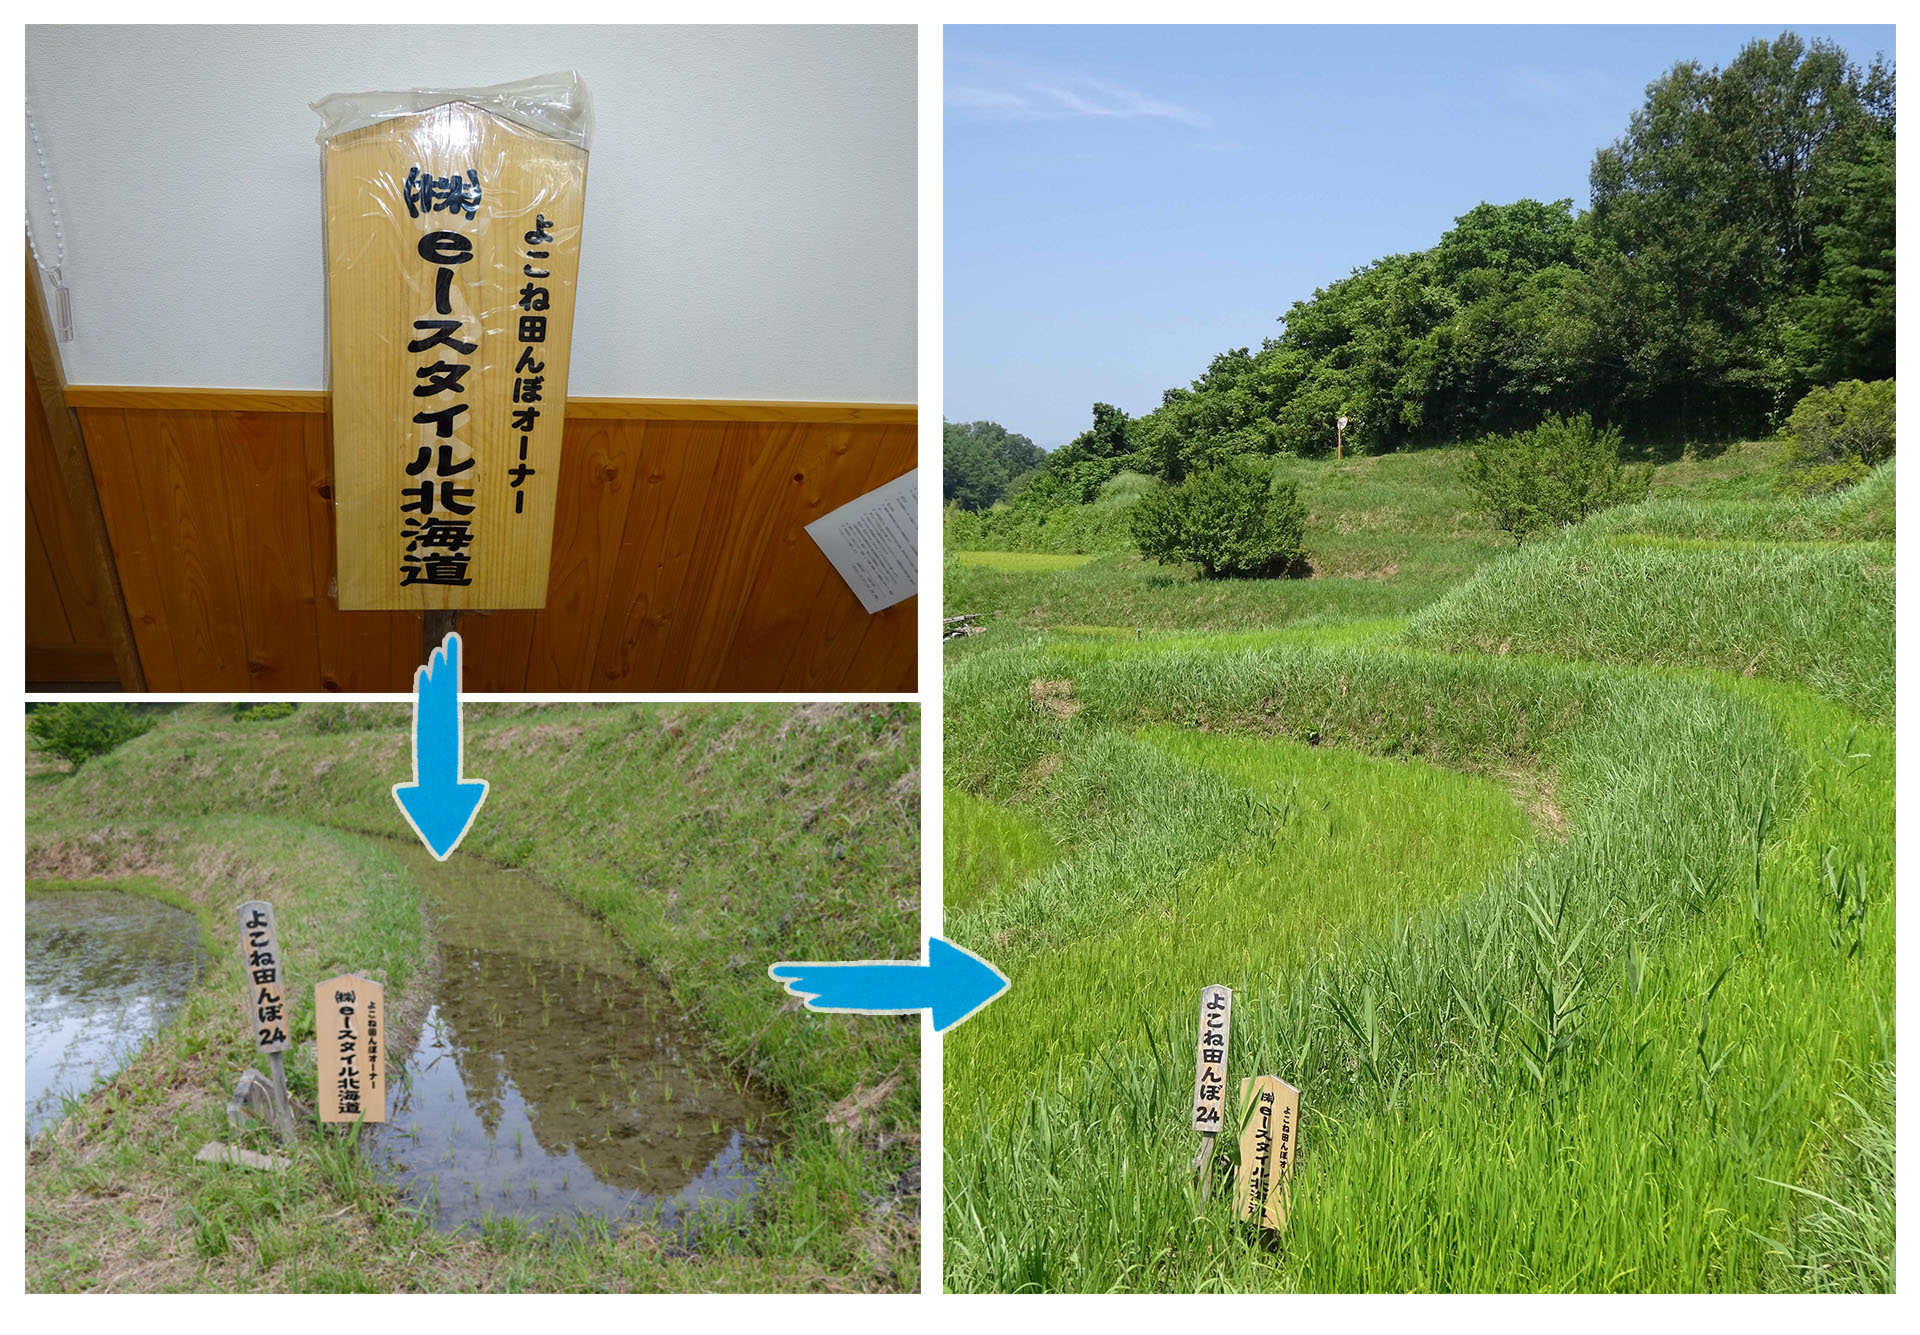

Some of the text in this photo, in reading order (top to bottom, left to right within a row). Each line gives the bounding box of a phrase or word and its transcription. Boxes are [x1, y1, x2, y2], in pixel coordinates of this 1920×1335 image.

[507, 213, 554, 515] よこね田んぼオーナー
[367, 1001, 378, 1089] よこね田んぼオーナー
